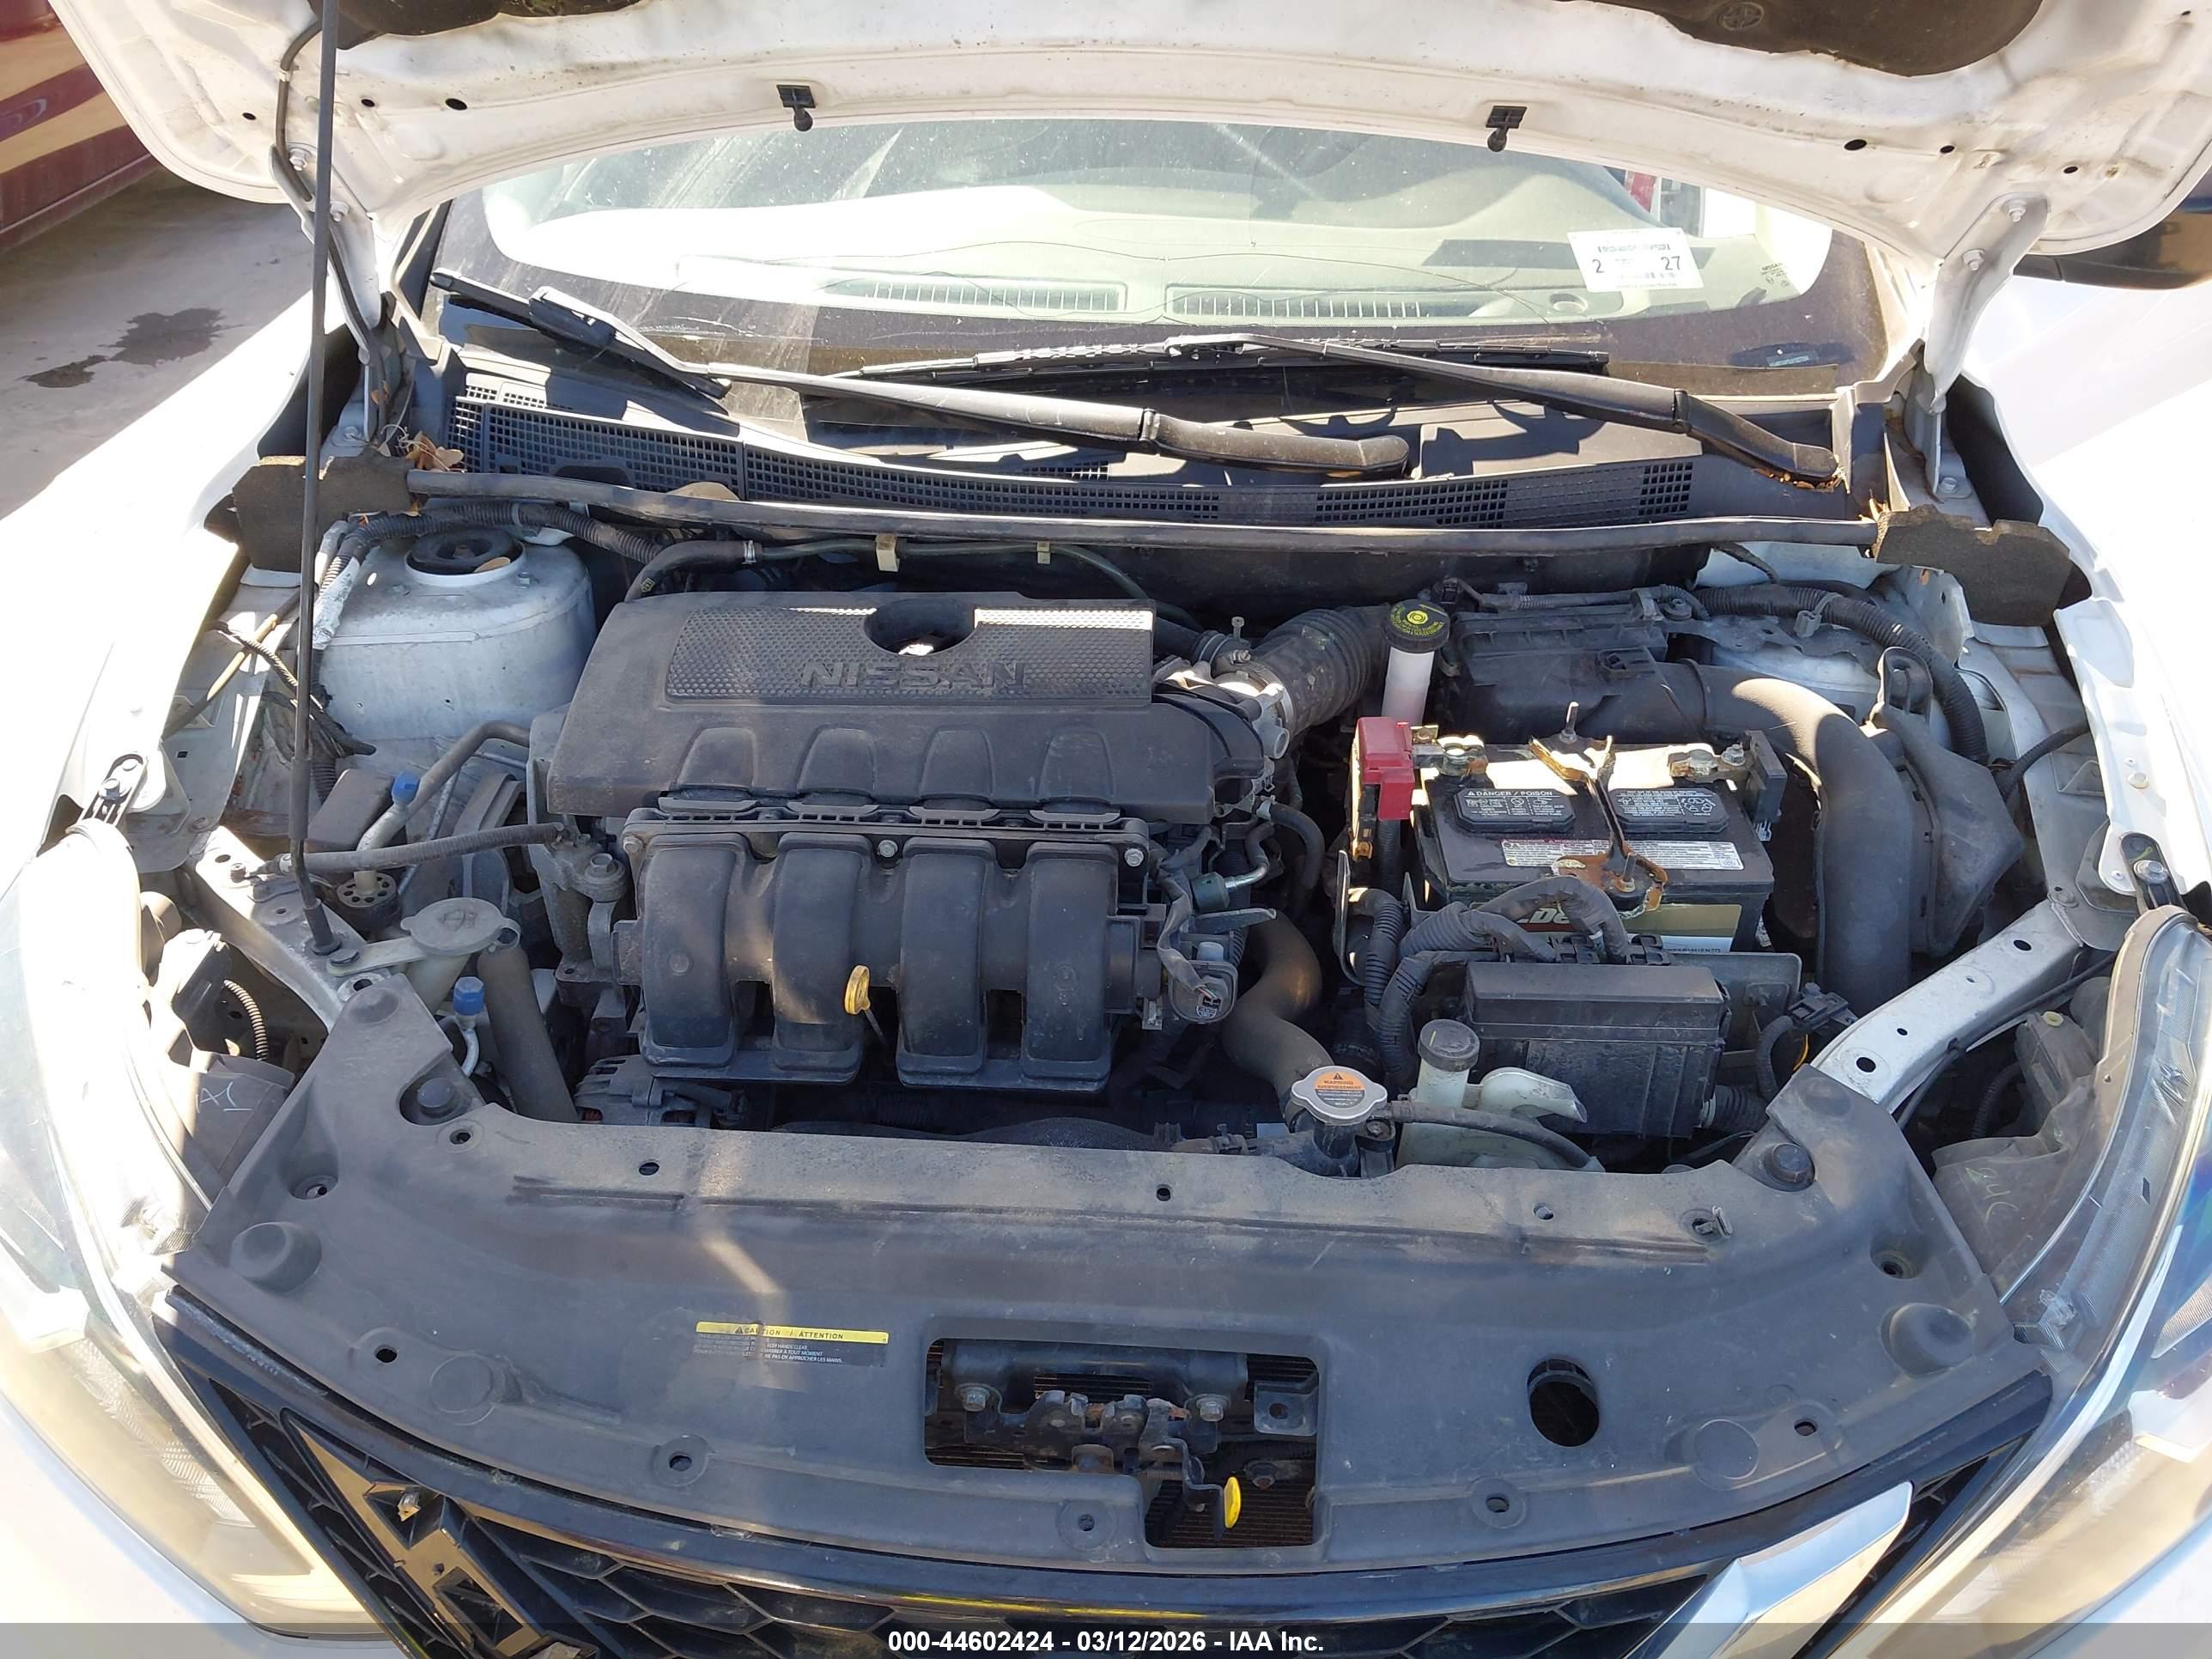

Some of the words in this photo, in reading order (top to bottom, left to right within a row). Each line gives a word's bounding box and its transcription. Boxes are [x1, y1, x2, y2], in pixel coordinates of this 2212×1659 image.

[1591, 258, 1605, 273] 2
[1660, 255, 1680, 270] 27
[799, 662, 1024, 690] NISSAN
[744, 1327, 781, 1336] CAUTION
[798, 1330, 844, 1340] ATTENTION
